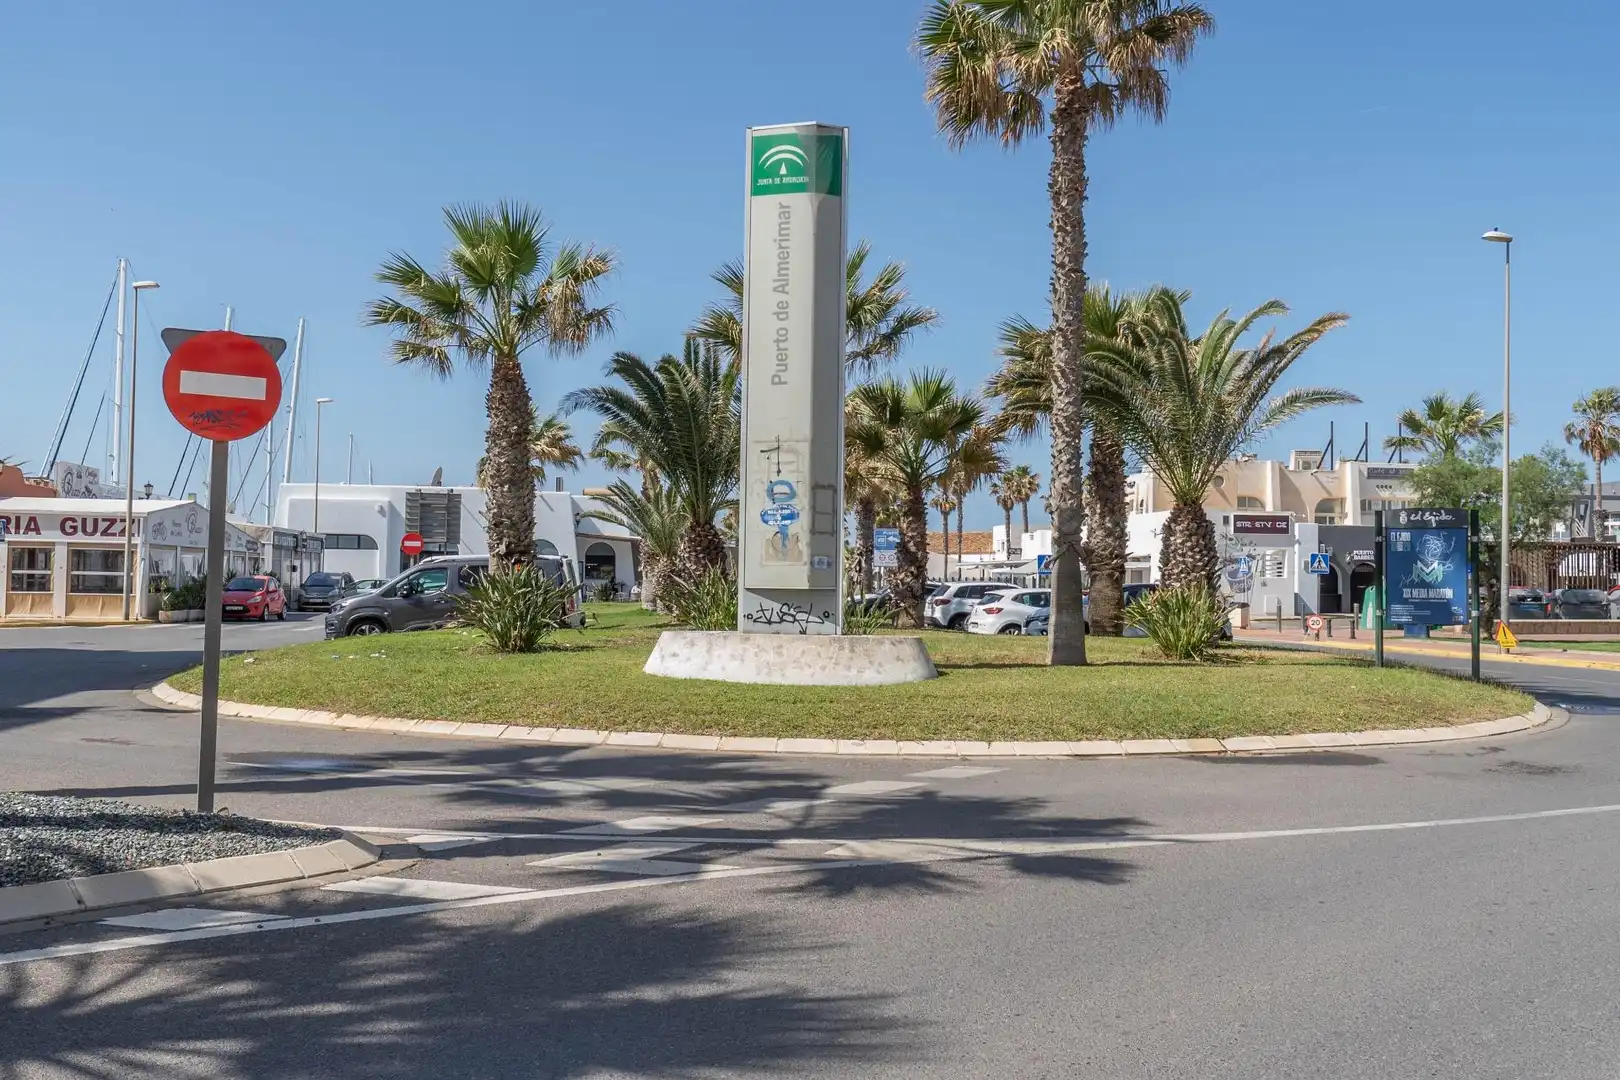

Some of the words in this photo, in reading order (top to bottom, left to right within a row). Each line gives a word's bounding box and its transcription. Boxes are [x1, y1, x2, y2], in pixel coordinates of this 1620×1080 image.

[774, 177, 782, 185] DE
[773, 201, 792, 295] Almerimar
[772, 300, 789, 324] de
[771, 330, 789, 386] Puerto
